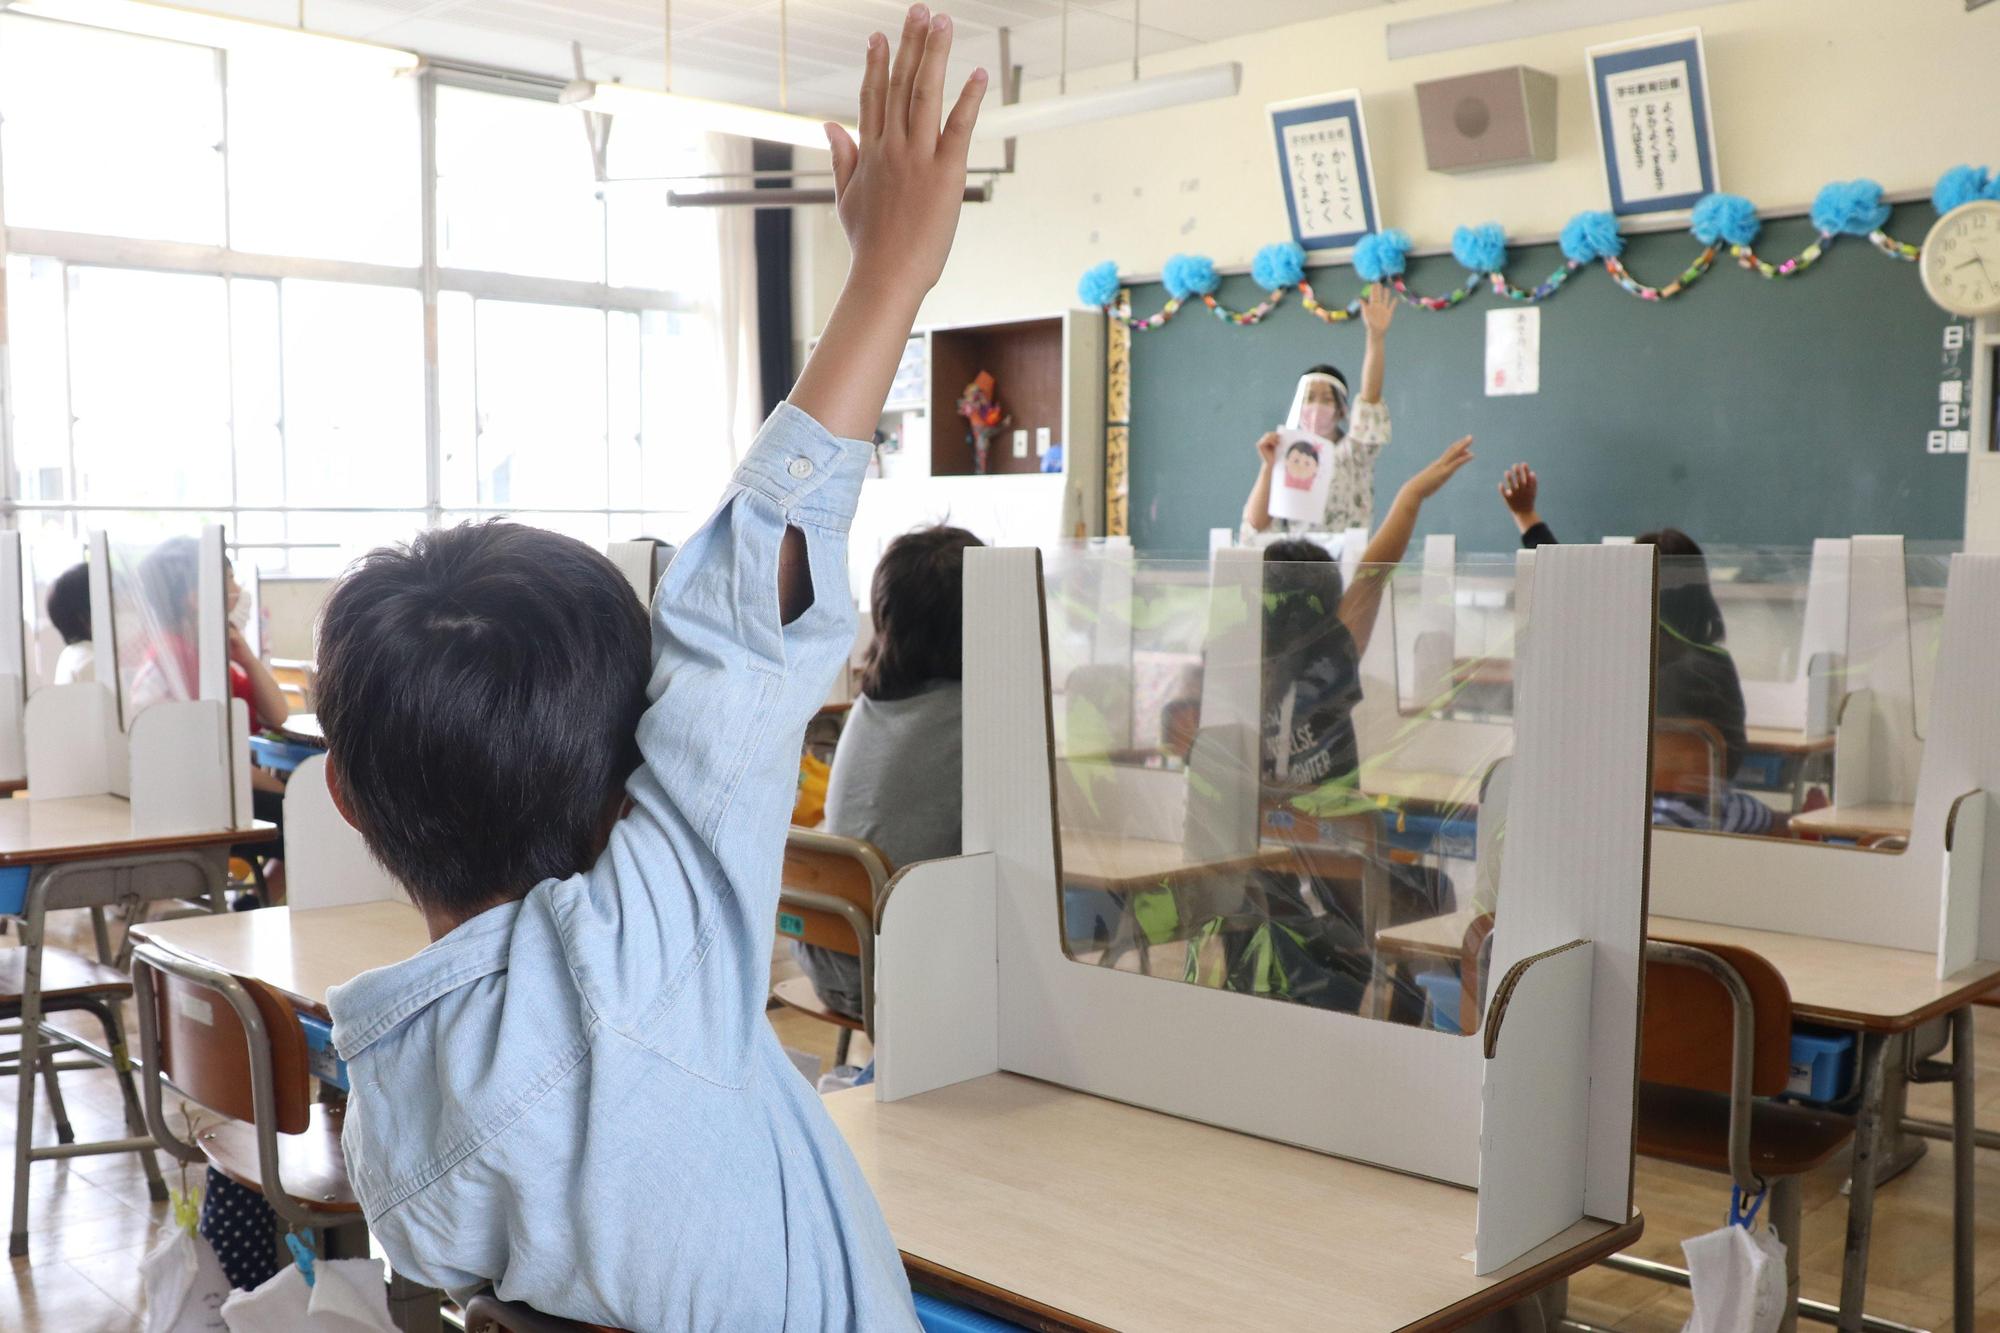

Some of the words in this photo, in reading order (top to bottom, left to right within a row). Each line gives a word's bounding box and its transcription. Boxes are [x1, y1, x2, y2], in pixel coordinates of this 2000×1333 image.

[1293, 152, 1315, 230] たくましく
[1311, 150, 1333, 224] なかよく
[1332, 148, 1353, 221] かしこく
[1973, 213, 1985, 228] 12
[1957, 223, 1968, 236] 11
[1944, 238, 1957, 251] 10
[1937, 255, 1946, 268] 9
[1944, 274, 1952, 286] 8
[1959, 283, 1967, 296] 7
[1975, 288, 1983, 301] 6
